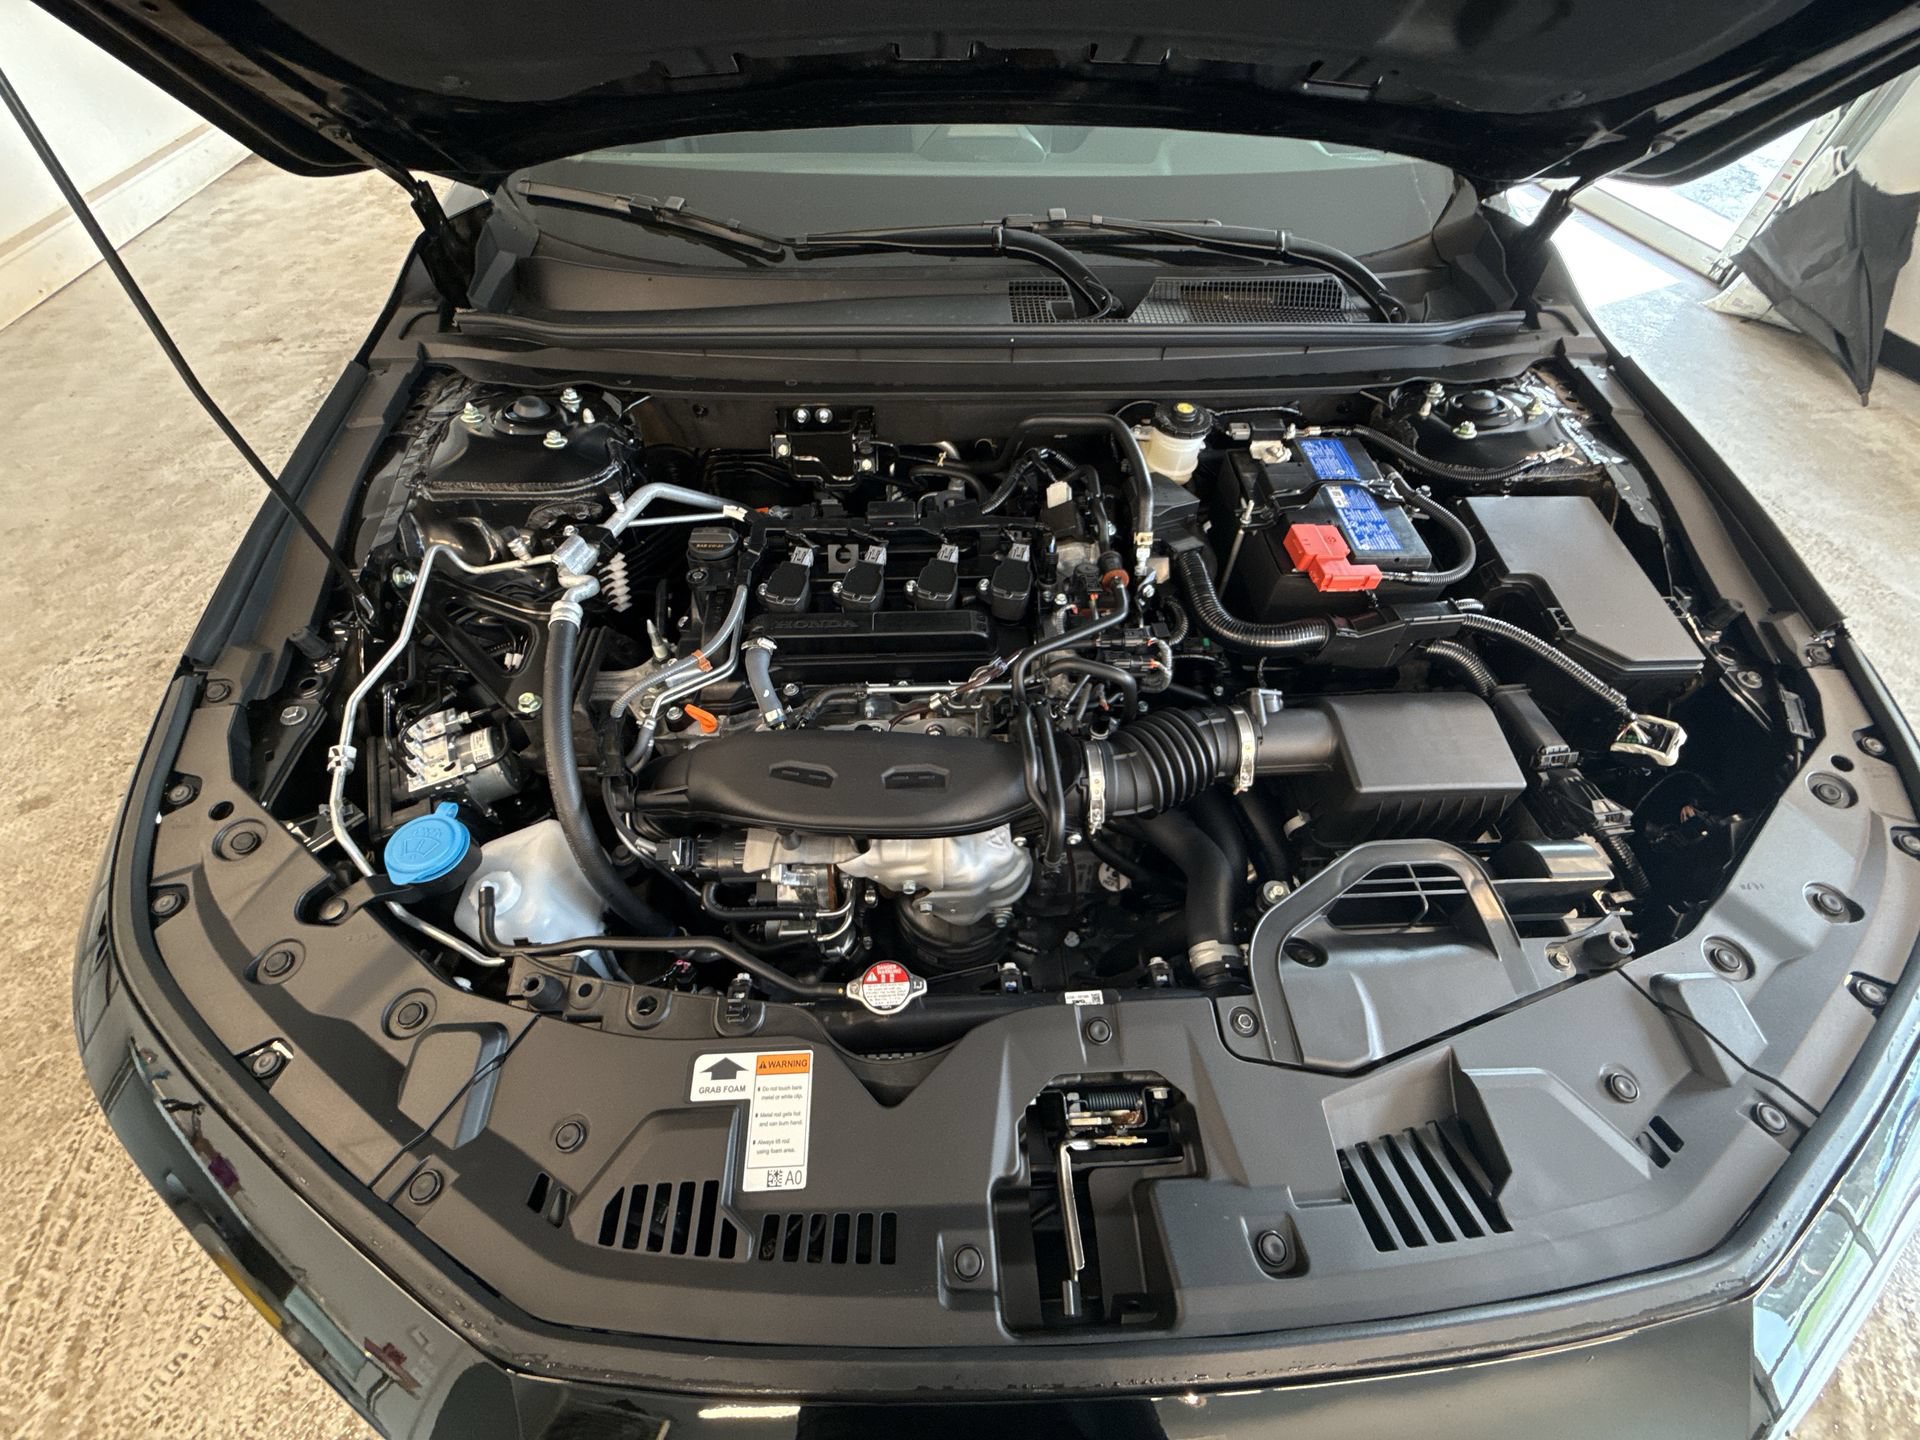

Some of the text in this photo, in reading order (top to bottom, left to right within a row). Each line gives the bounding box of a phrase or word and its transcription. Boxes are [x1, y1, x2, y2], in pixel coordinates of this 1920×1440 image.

[775, 618, 858, 629] HONDA
[768, 1058, 808, 1068] WARNING
[698, 1085, 746, 1094] GRAB FOAM
